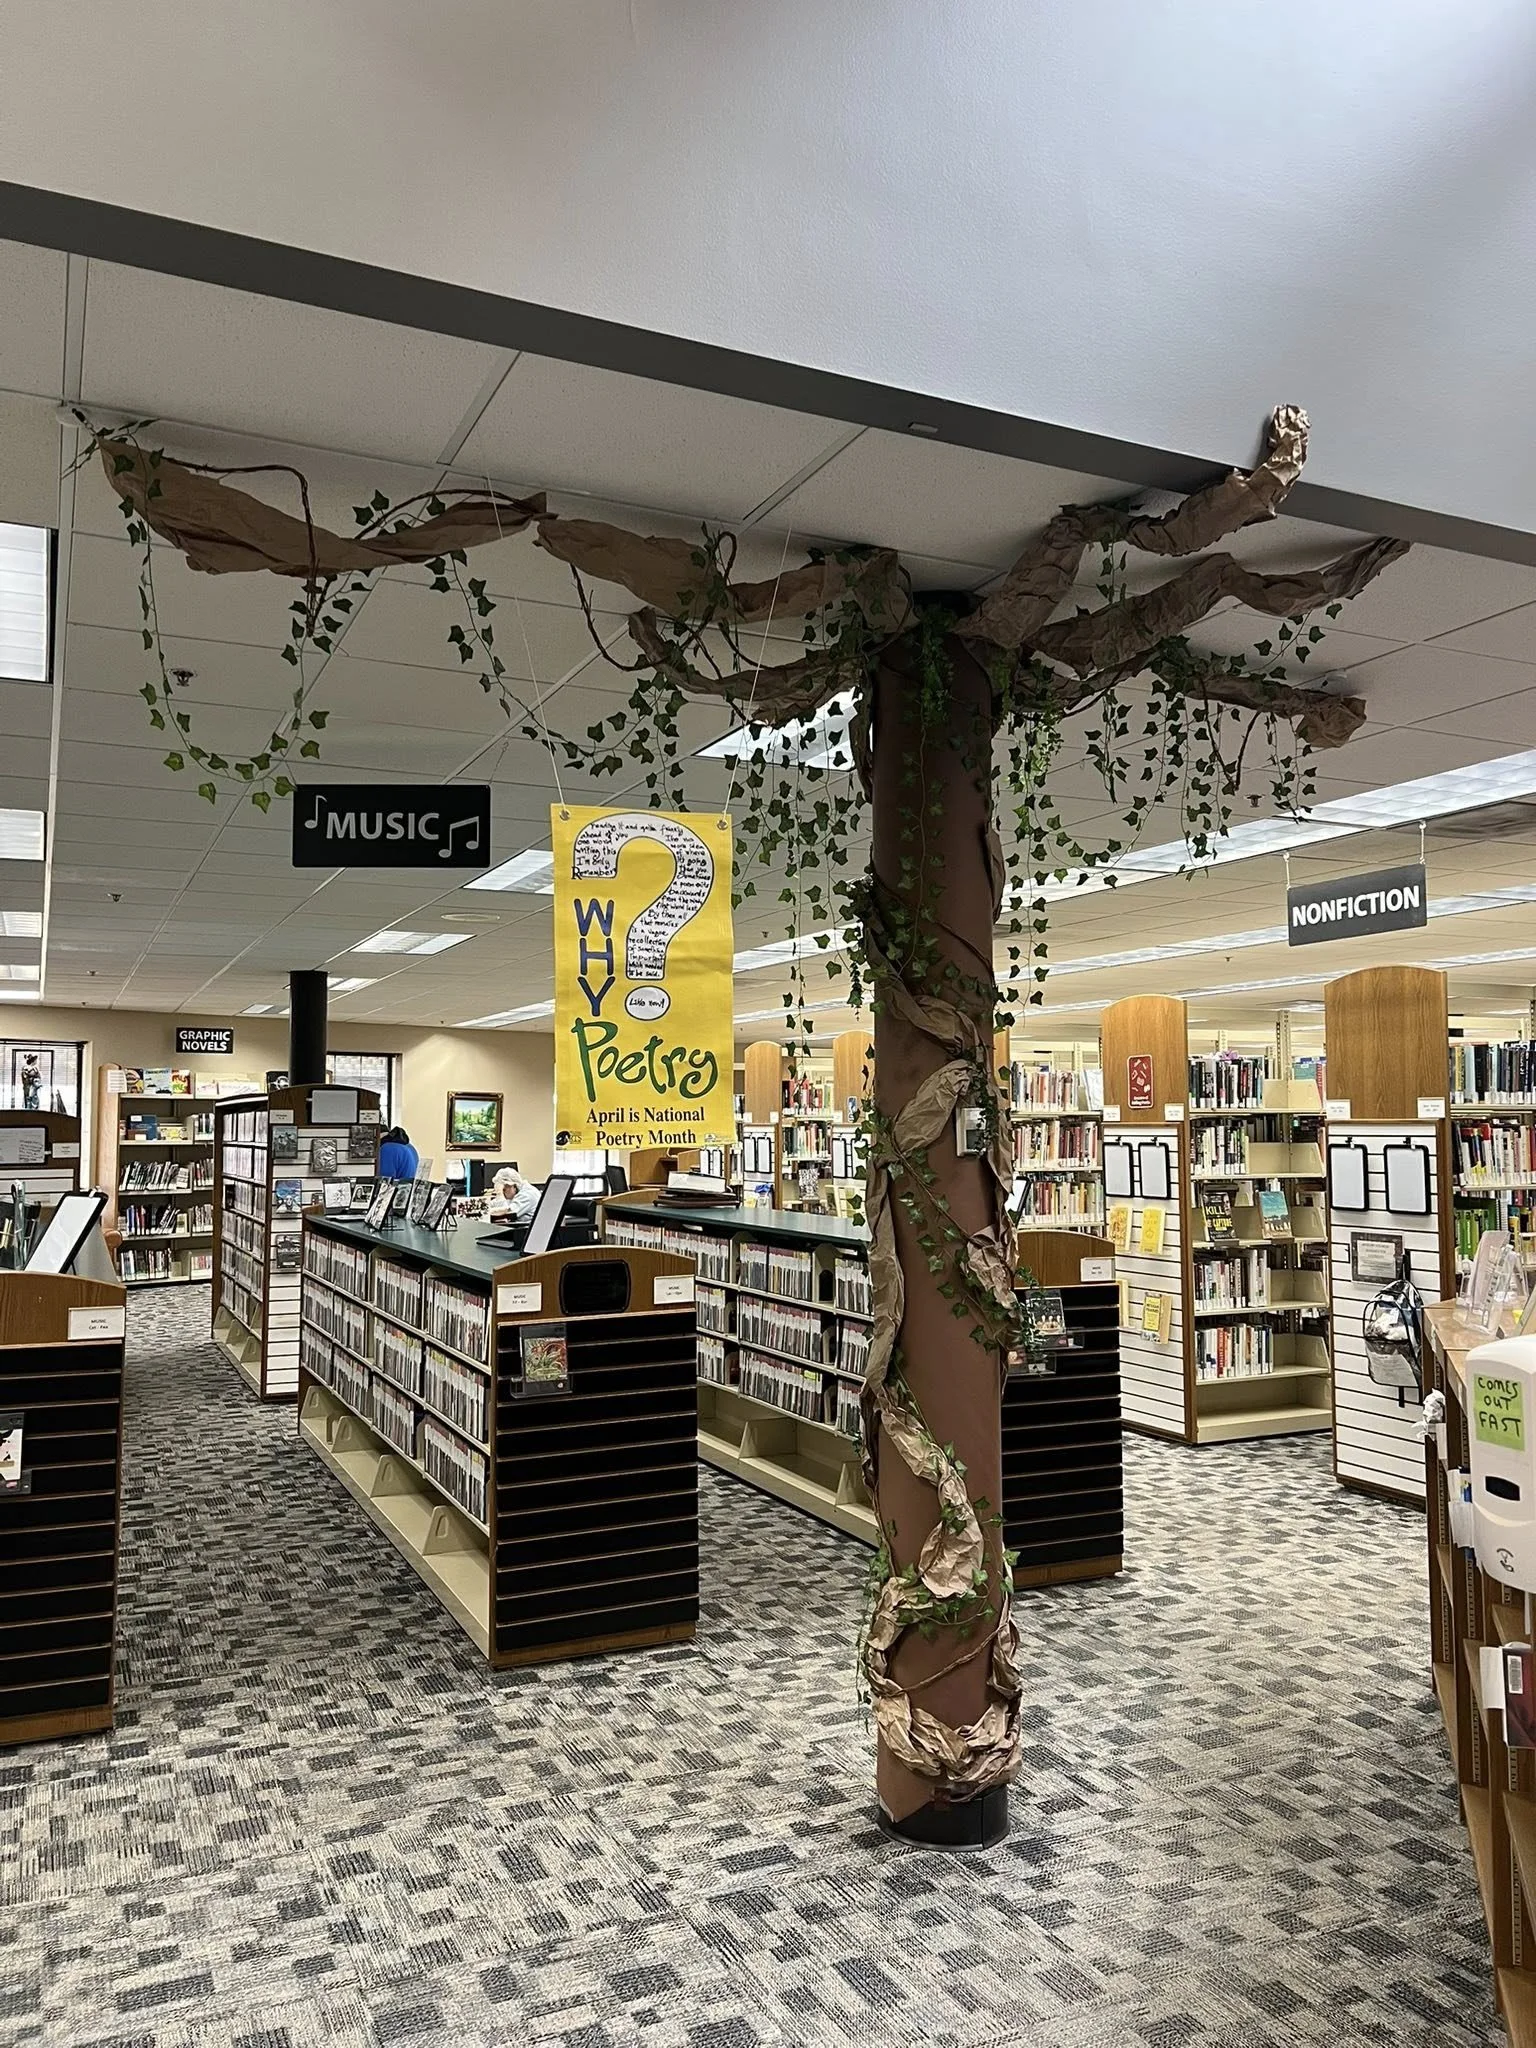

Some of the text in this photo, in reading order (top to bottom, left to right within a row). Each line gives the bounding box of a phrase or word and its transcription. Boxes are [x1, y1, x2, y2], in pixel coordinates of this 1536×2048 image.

[326, 812, 440, 840] MUSIC
[602, 845, 616, 855] this
[648, 909, 659, 920] By
[1292, 885, 1420, 927] NONFICTION
[179, 1030, 231, 1041] GRAPHIC
[182, 1041, 227, 1051] NOVELS
[571, 1017, 718, 1103] Poetry
[587, 1107, 705, 1127] April is National
[596, 1130, 643, 1148] Poetry
[648, 1129, 697, 1145] Month
[1205, 1205, 1226, 1216] KILL
[1478, 1377, 1518, 1399] COMES
[1483, 1395, 1512, 1411] OUT
[1479, 1411, 1521, 1437] FAST
